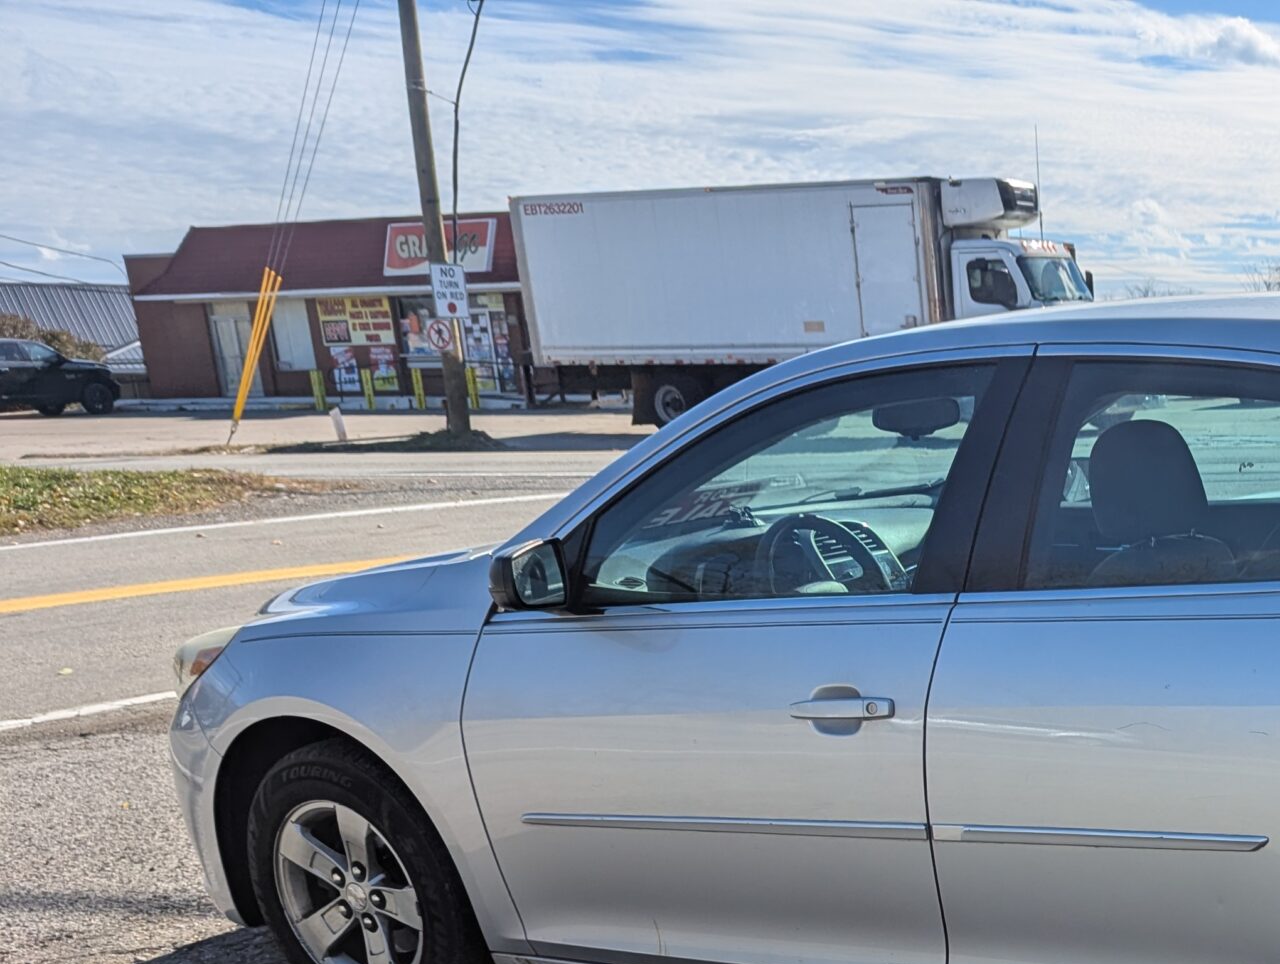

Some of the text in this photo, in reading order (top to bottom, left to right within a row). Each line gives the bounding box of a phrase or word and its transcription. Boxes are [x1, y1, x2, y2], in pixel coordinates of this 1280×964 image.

[523, 201, 584, 216] EBT2632201
[440, 267, 455, 278] NO
[439, 280, 460, 289] TURN
[436, 291, 465, 301] ON RED
[280, 764, 353, 788] TOURING
